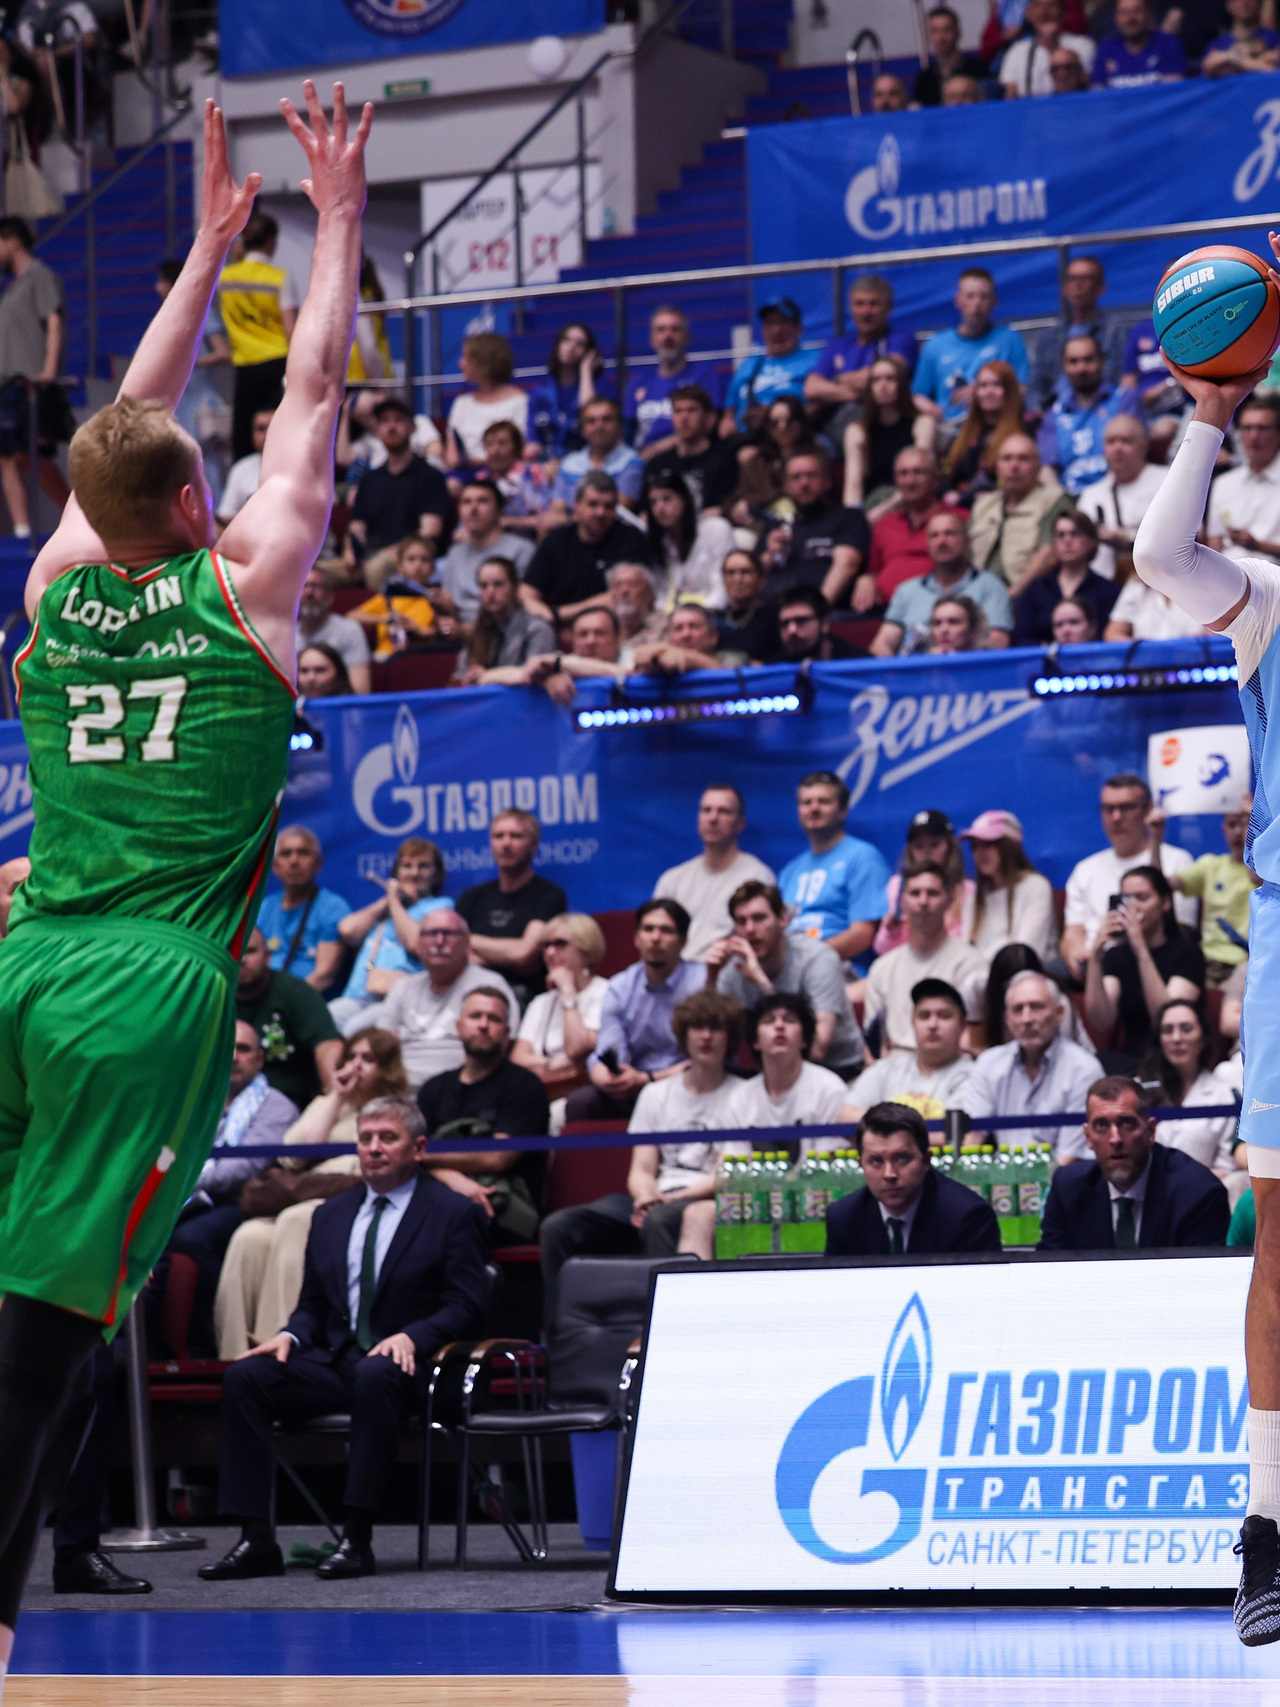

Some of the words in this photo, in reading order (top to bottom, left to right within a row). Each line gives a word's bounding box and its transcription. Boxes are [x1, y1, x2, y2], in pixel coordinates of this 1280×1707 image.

[904, 178, 1047, 235] ГАЗПРОМ
[1157, 266, 1215, 314] SIBUR
[61, 575, 183, 635] LOPIN
[65, 675, 188, 763] 27
[426, 773, 599, 834] ГАЗПРОМ
[938, 1366, 1250, 1457] ГАЗПРОМ
[946, 1474, 1249, 1511] ТРАНСГАЗ
